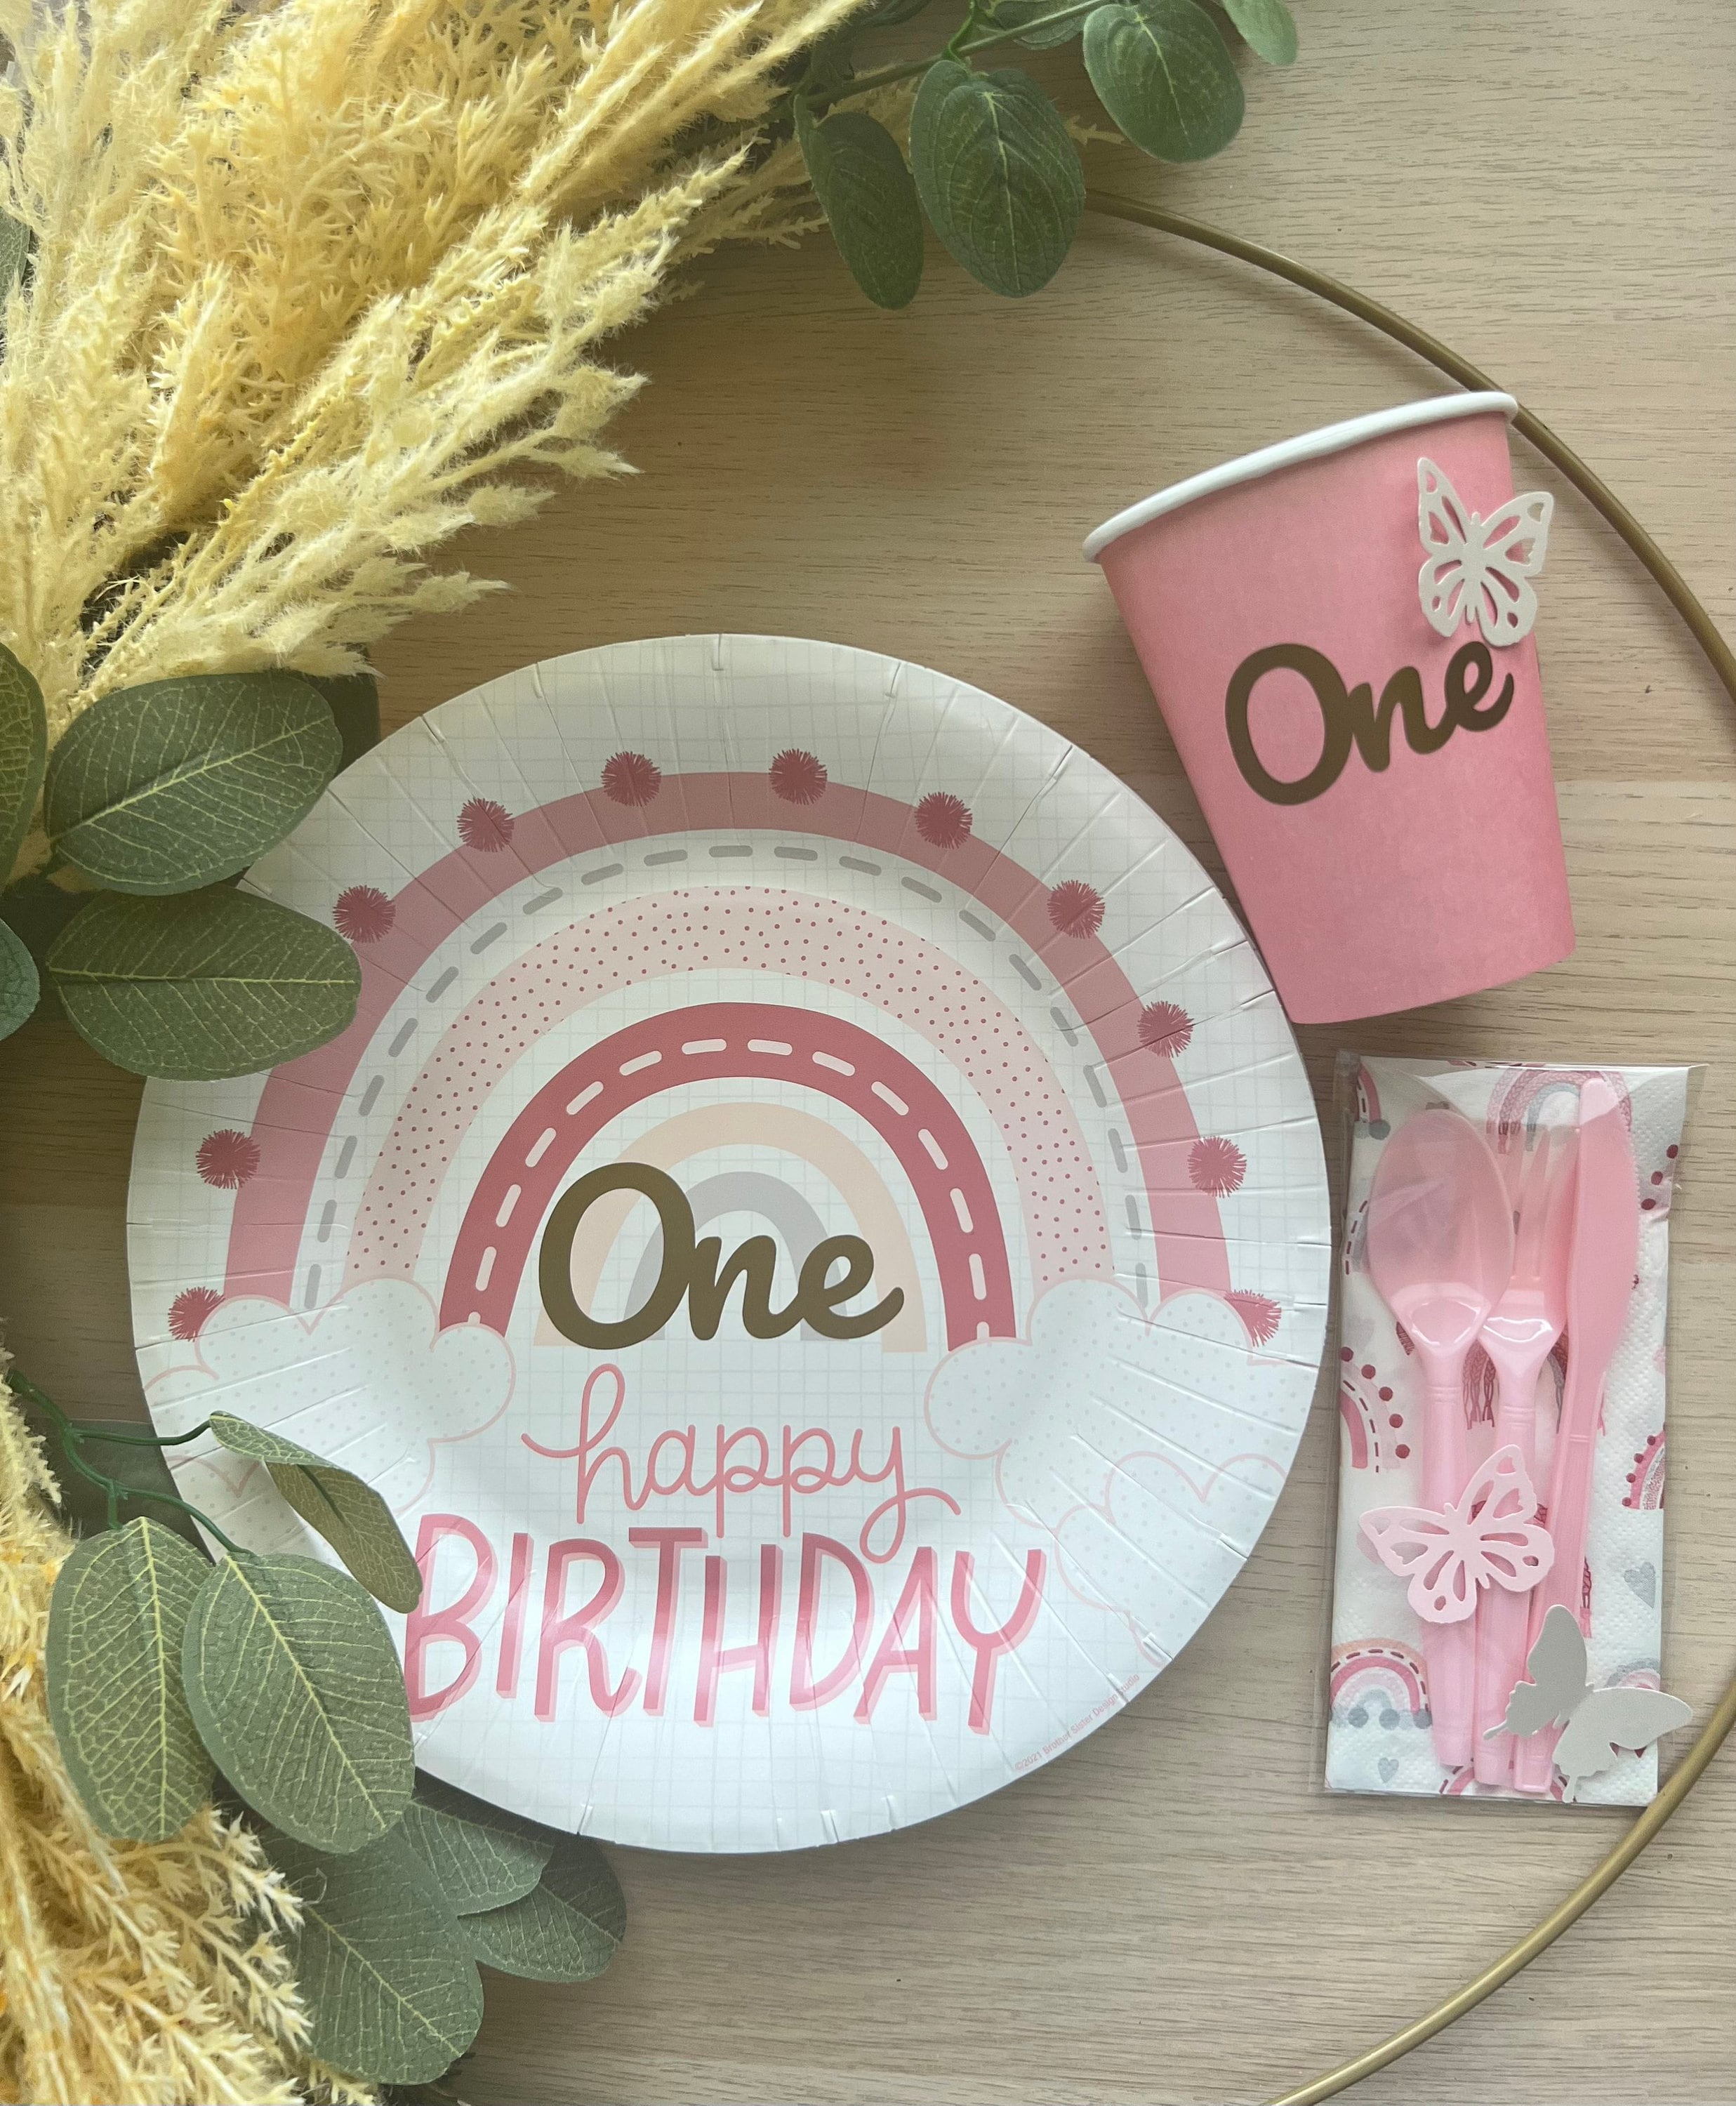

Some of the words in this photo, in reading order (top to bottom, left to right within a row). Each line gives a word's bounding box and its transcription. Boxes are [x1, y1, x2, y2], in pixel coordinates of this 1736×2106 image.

[1225, 642, 1513, 806] One
[538, 1162, 904, 1350] One
[522, 1363, 962, 1563] happy
[404, 1514, 1047, 1734] BIRTHDAY
[1043, 1732, 1071, 1754] Brother
[1071, 1714, 1093, 1734] Sister
[1093, 1694, 1117, 1716] Design
